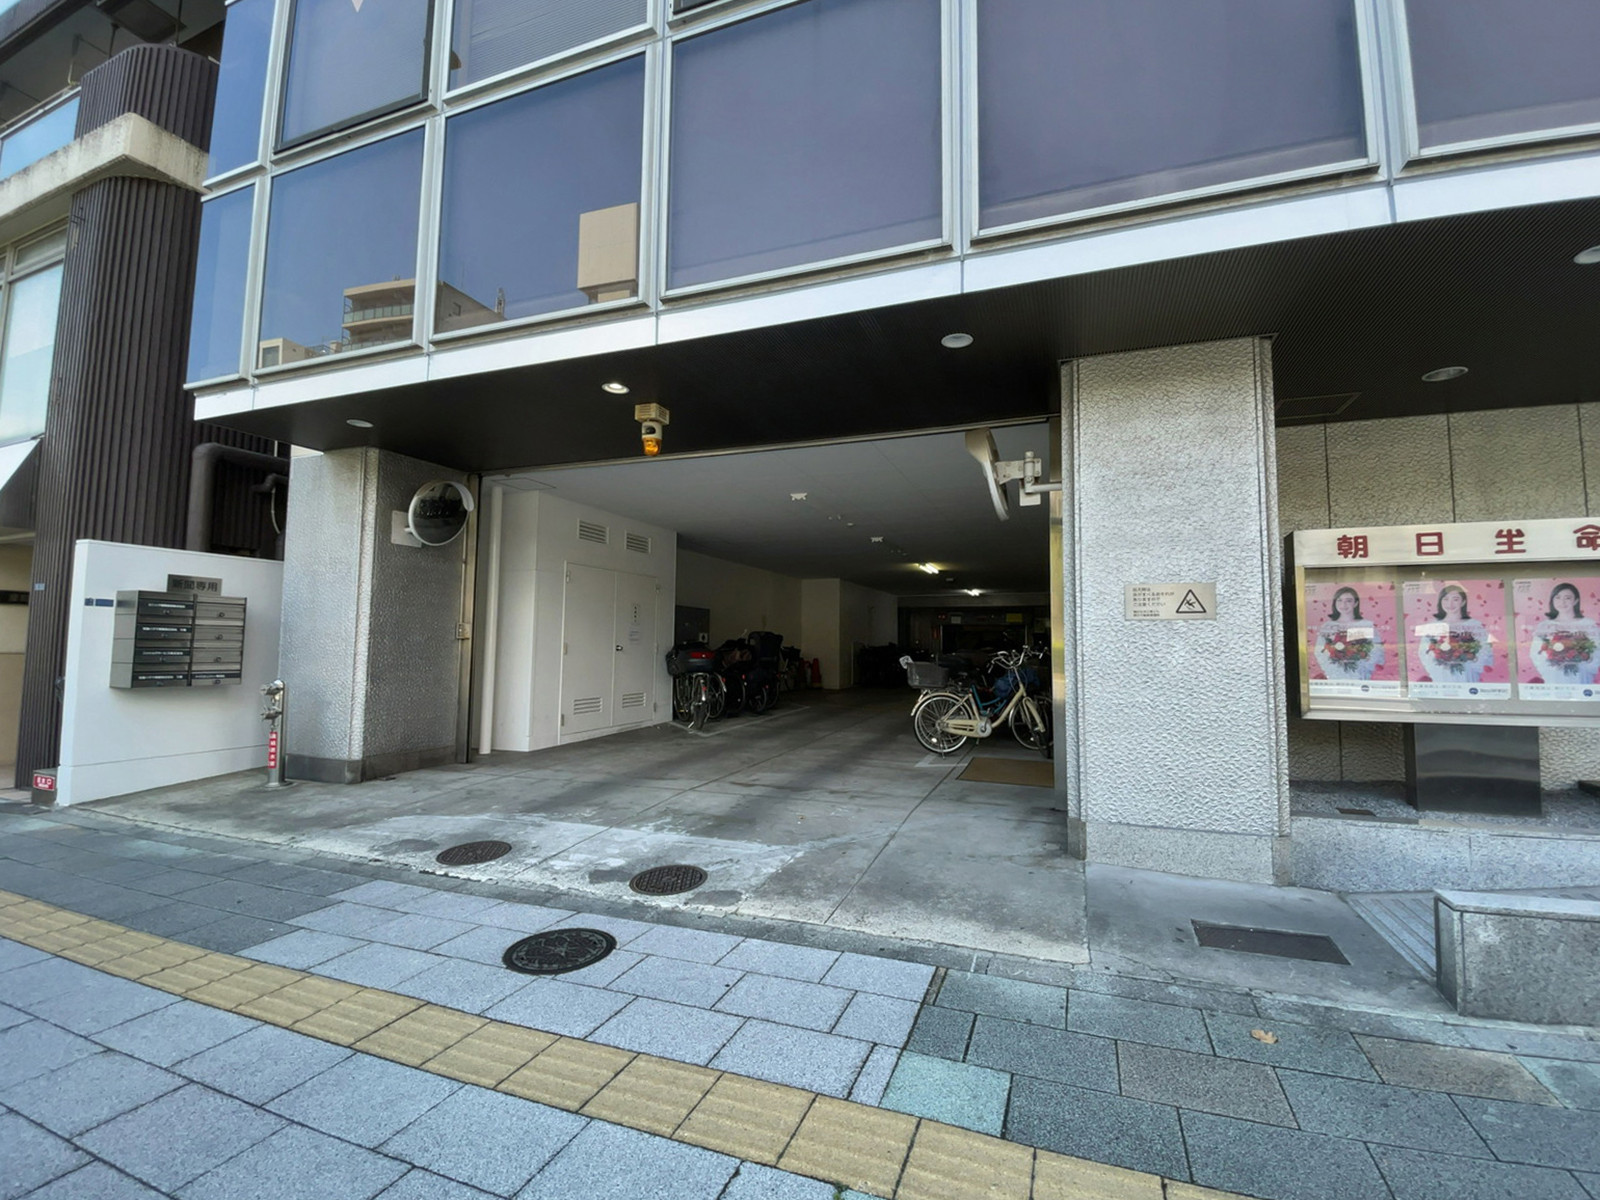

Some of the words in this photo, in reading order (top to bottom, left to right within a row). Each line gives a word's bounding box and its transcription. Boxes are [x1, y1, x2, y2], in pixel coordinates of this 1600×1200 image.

[1336, 523, 1600, 559] 朝日生命
[172, 578, 218, 592] 新聞専用
